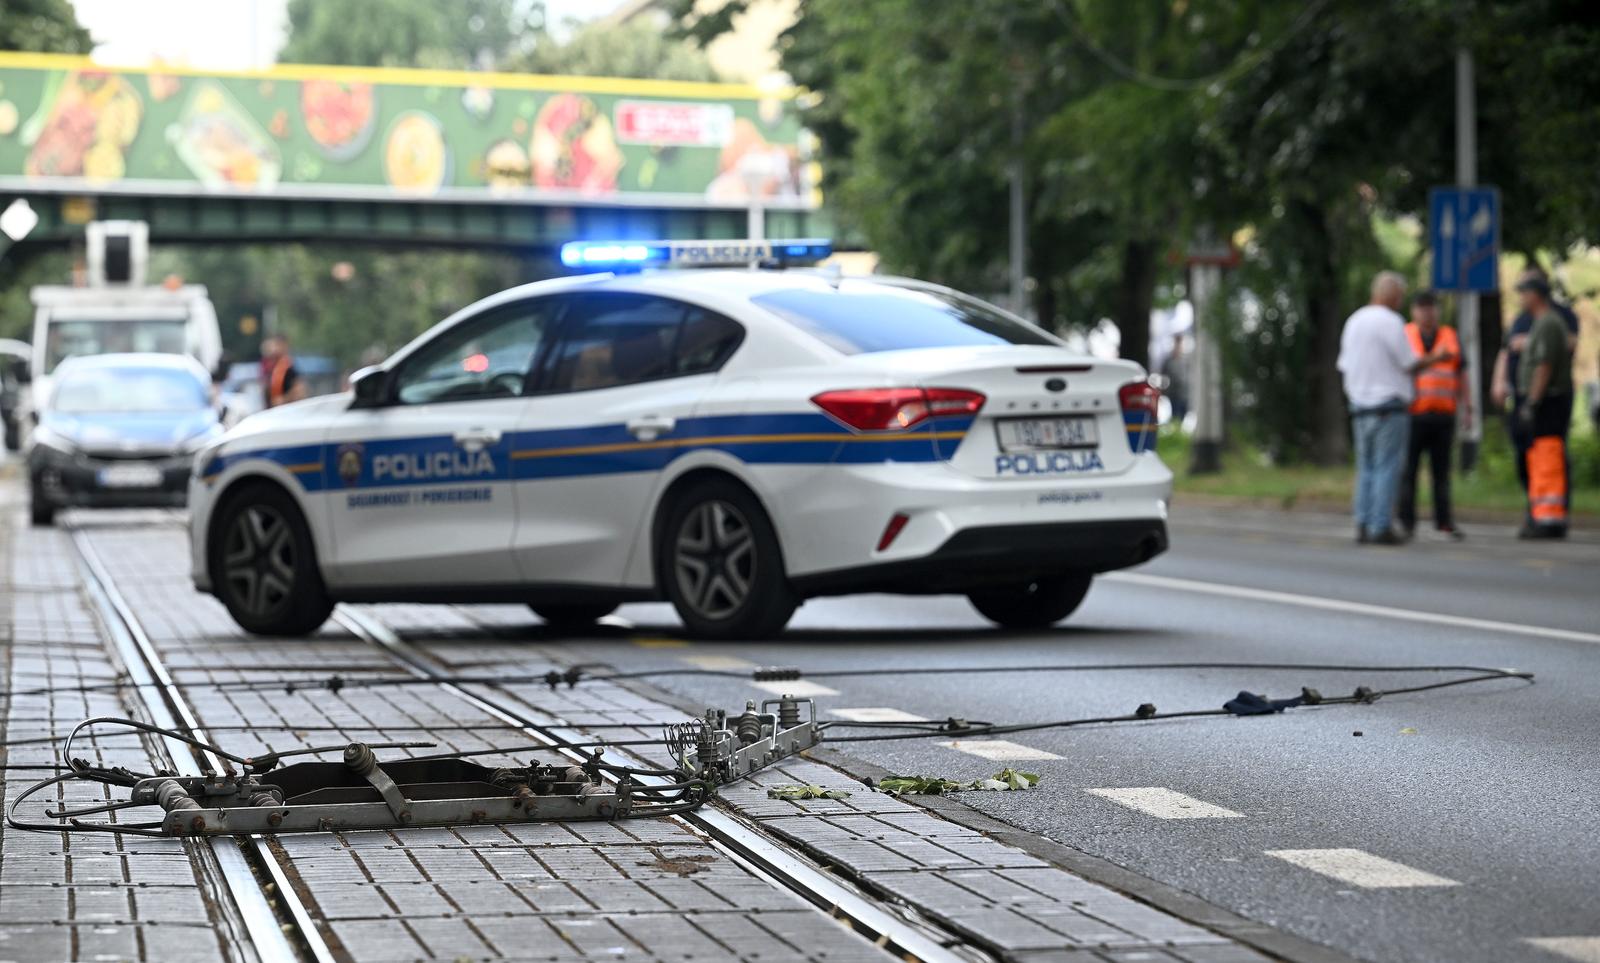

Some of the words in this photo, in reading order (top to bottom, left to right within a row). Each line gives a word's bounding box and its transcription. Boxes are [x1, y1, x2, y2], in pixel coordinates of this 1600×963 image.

[674, 244, 766, 259] POLICIJA
[373, 450, 495, 480] POLICIJA
[996, 451, 1104, 474] POLICIJA
